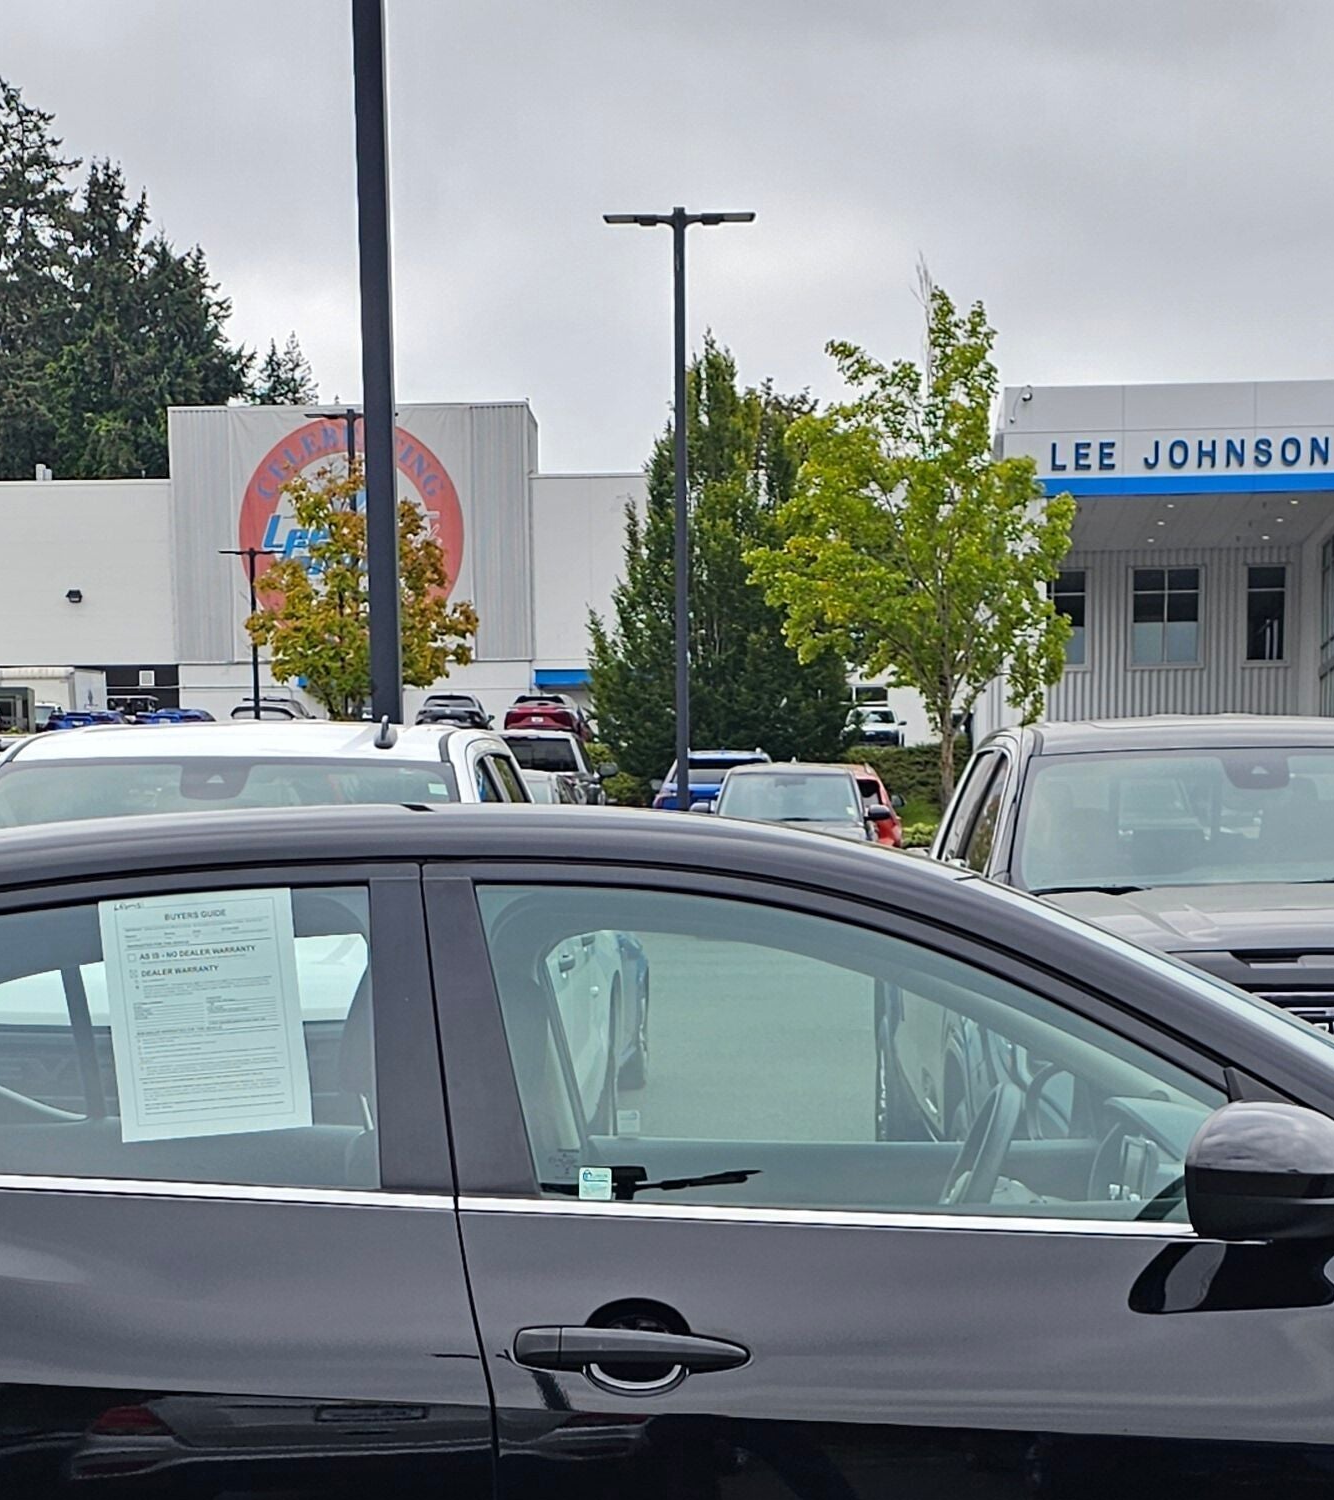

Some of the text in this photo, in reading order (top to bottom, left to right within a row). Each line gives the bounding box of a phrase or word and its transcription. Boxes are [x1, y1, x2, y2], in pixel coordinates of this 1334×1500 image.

[1050, 436, 1330, 471] LEE JOHNSON
[257, 422, 443, 500] CELEBING
[164, 909, 227, 921] BUYERS GUIDE
[179, 949, 210, 957] DEALER
[212, 945, 256, 955] WARRANTY
[141, 965, 219, 977] DEALER WARRANTY
